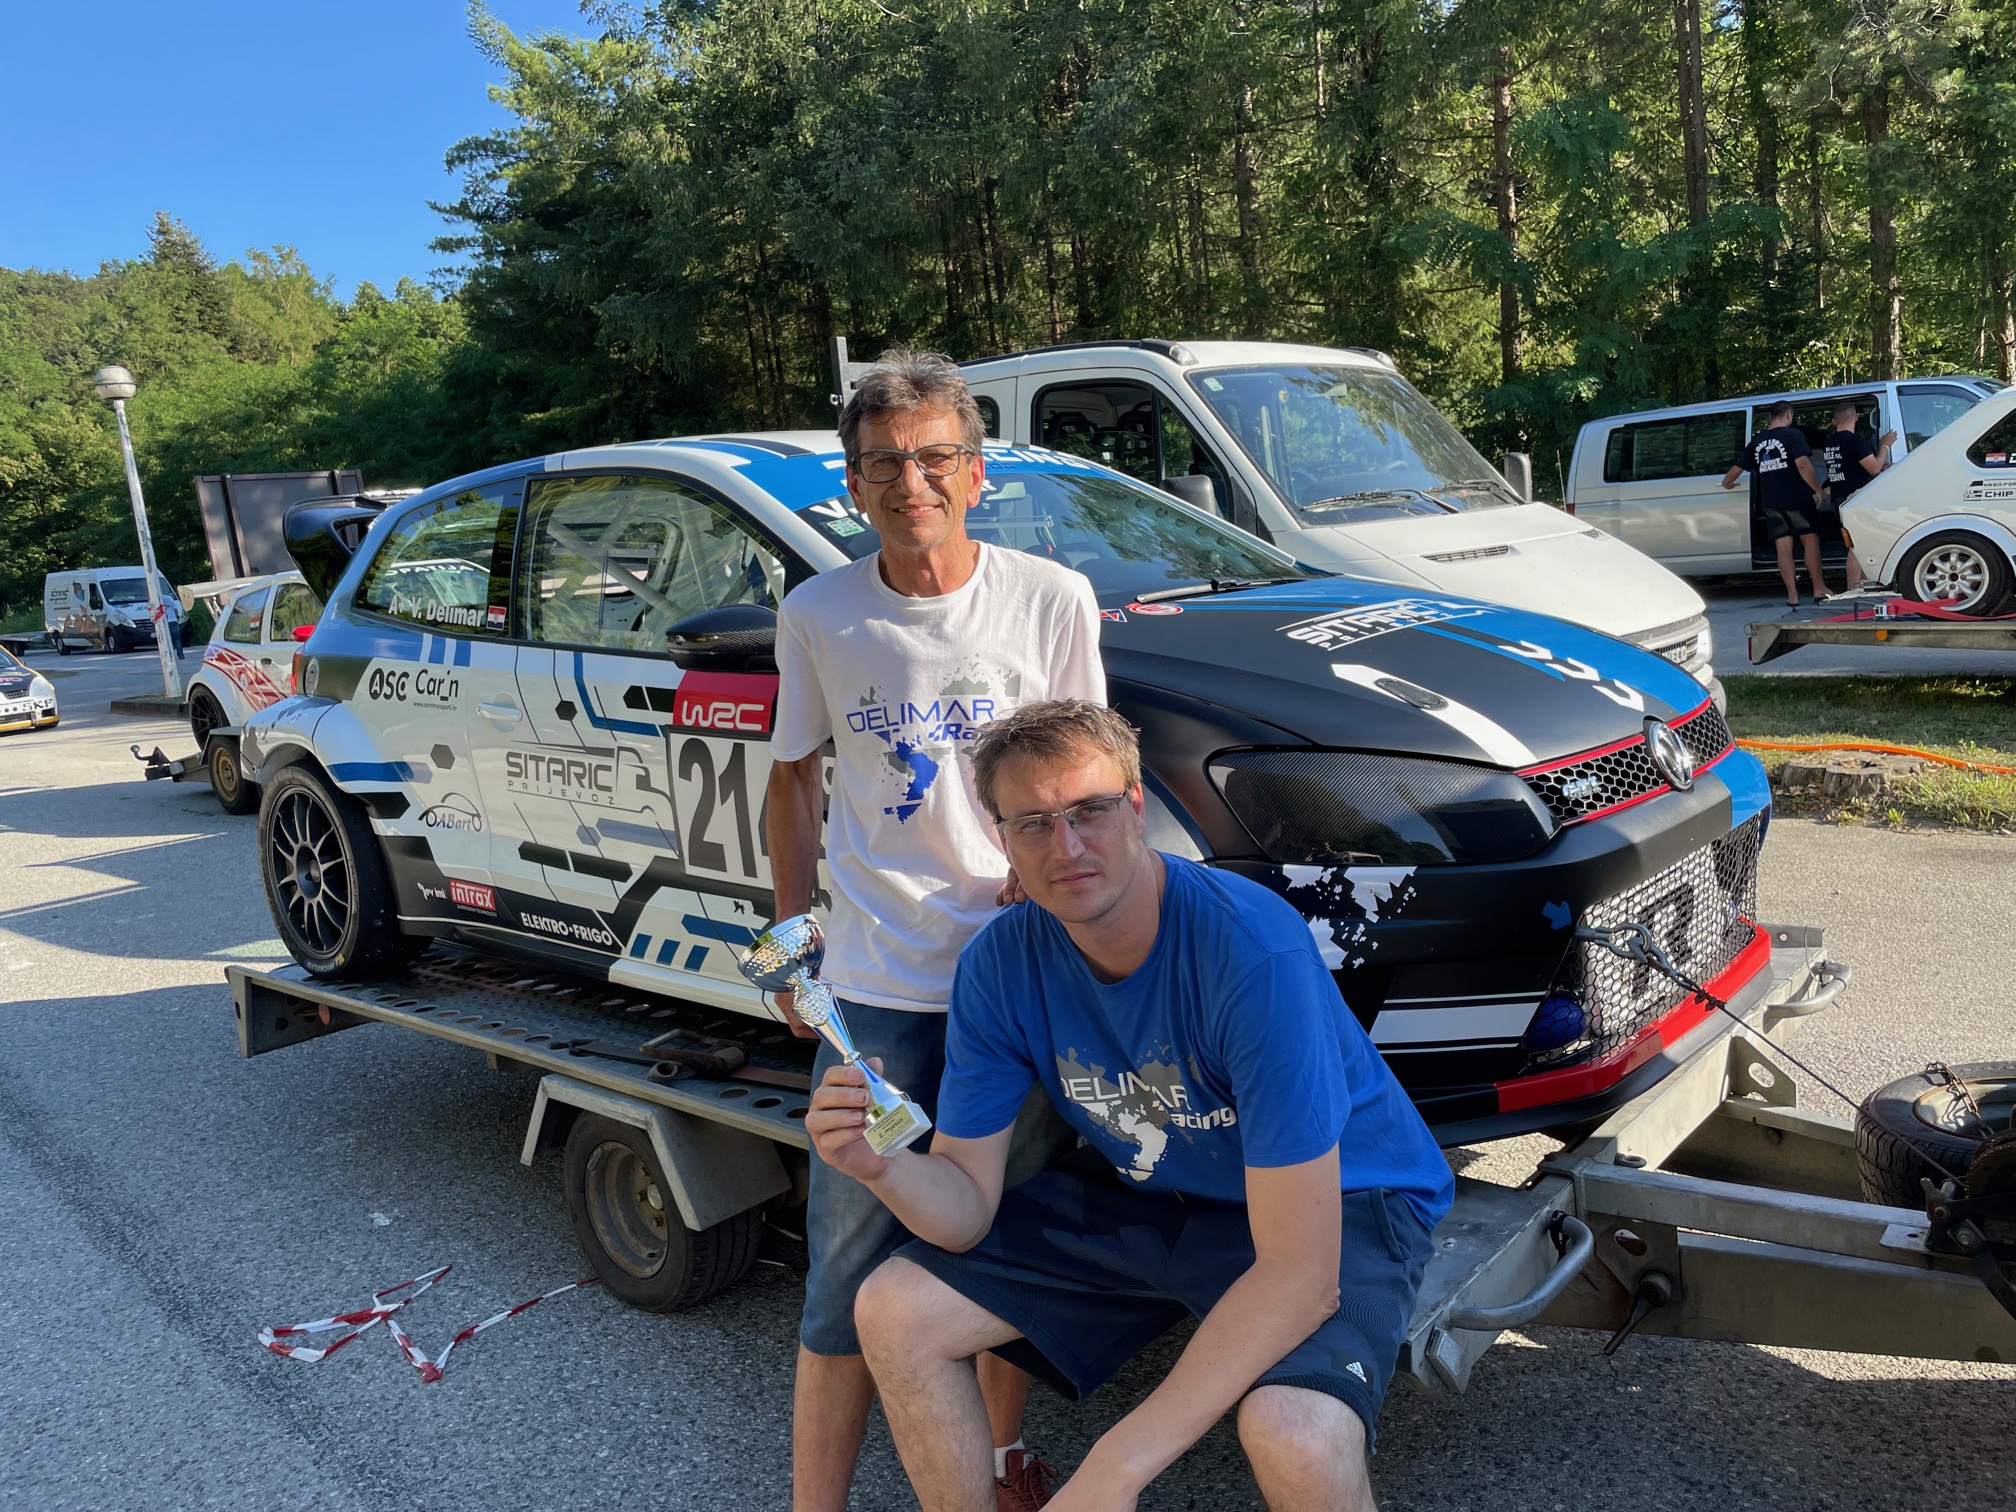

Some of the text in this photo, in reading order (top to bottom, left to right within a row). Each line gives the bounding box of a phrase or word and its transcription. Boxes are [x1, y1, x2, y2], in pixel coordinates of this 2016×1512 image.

[1984, 490, 2014, 498] CHIP
[426, 599, 485, 627] Delimar
[22, 699, 53, 712] SKF
[681, 700, 765, 731] WRC
[846, 699, 995, 733] DELIMAR
[507, 780, 615, 805] PRIJEVOZ
